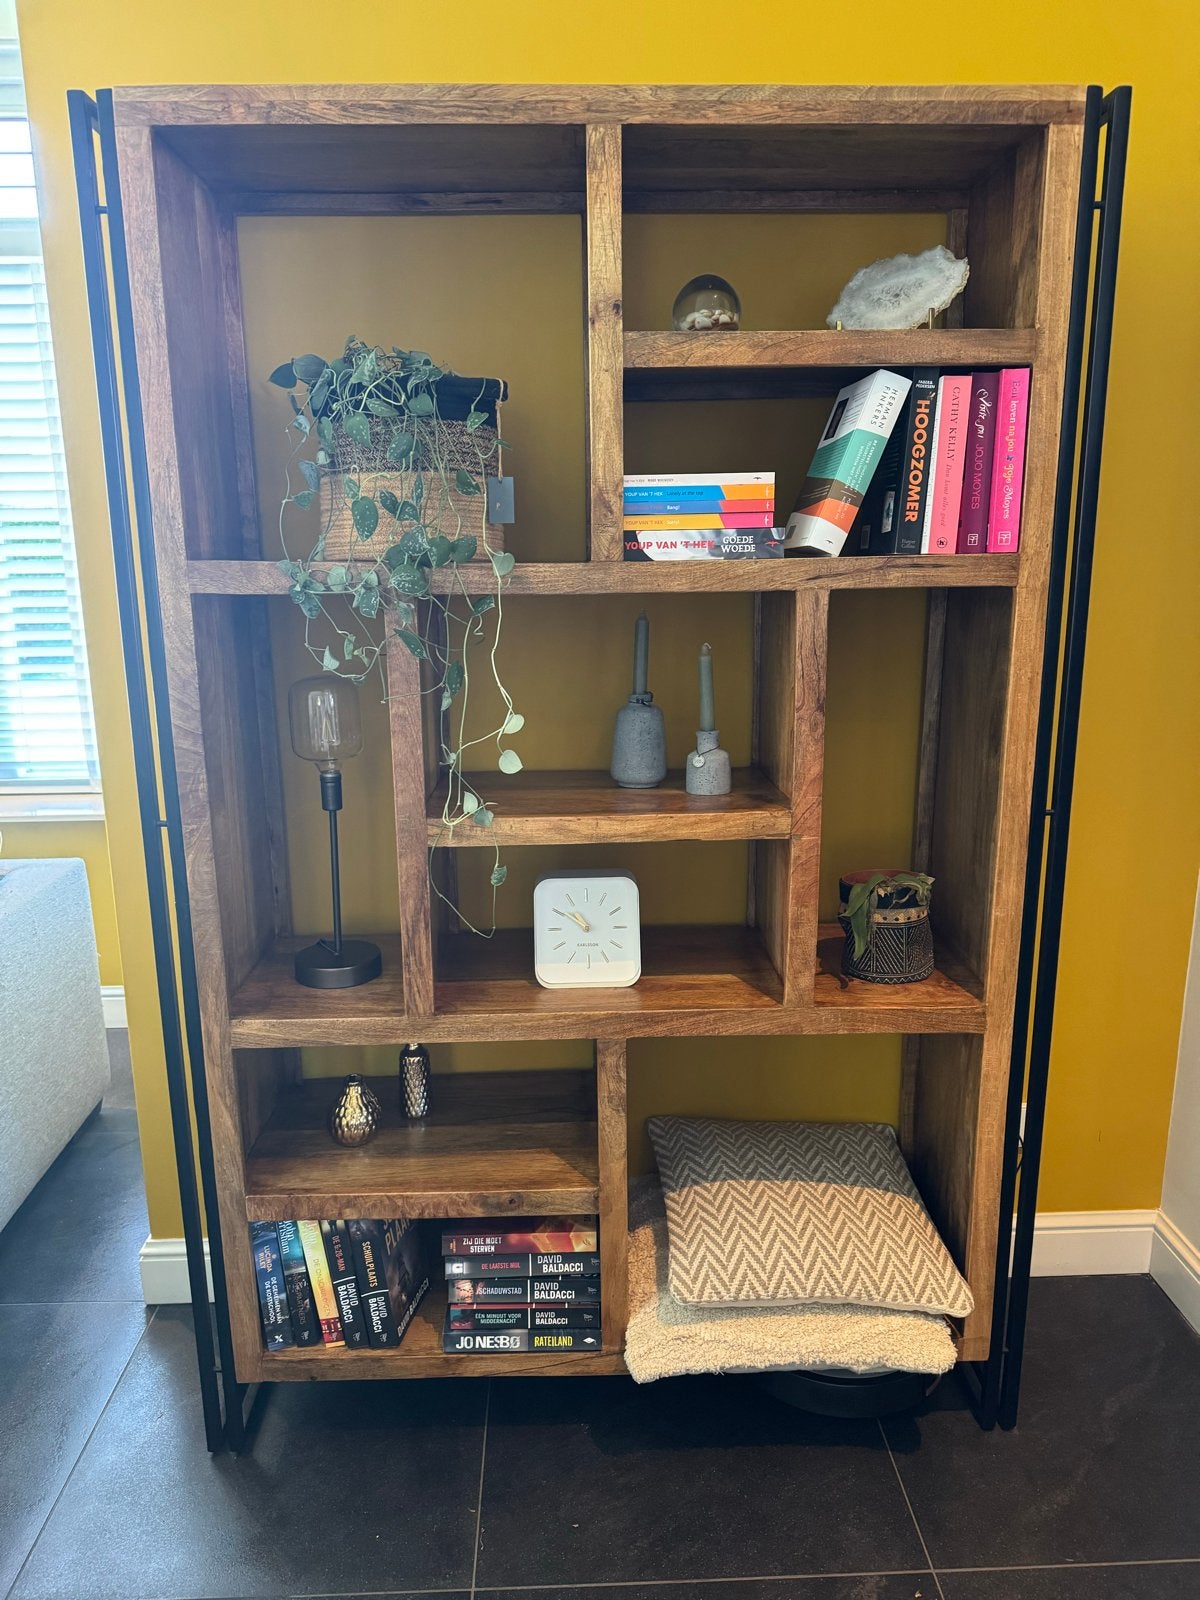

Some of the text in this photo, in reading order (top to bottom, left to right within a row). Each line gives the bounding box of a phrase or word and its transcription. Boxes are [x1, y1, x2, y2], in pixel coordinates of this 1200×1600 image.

[870, 385, 888, 425] FINKERS
[878, 388, 899, 429] HERMAN
[1009, 400, 1019, 423] leven
[947, 386, 961, 461] CATHY KELLY
[1008, 425, 1016, 435] na
[1005, 436, 1016, 452] jou
[905, 400, 931, 522] HOOGZOMER
[971, 444, 984, 510] JOJO MOYES
[1002, 486, 1013, 519] Moyes
[625, 541, 653, 550] YOUP
[655, 540, 677, 549] VAN
[689, 539, 715, 549] HEK
[722, 535, 754, 544] GOEDE
[720, 544, 756, 553] WOEDE
[278, 1220, 290, 1254] risham
[474, 1237, 484, 1245] DIE
[486, 1237, 502, 1245] MOET
[470, 1245, 495, 1253] STERVEN
[263, 1245, 273, 1273] LUCINDA
[362, 1241, 378, 1288] SCHUILPLAATS
[537, 1255, 562, 1264] DAVID
[542, 1262, 584, 1273] BALDACCI
[478, 1287, 522, 1295] SCHADUWSTAD
[534, 1282, 559, 1290] DAVID
[346, 1282, 359, 1307] DAVID
[534, 1290, 575, 1300] BALDACCI
[337, 1285, 354, 1324] BALDACCI
[376, 1296, 388, 1318] DAVID
[368, 1298, 383, 1333] BALDACCI
[535, 1317, 568, 1325] BALDACCI
[456, 1335, 521, 1349] JO NESBØ
[534, 1336, 573, 1347] RATEILAND
